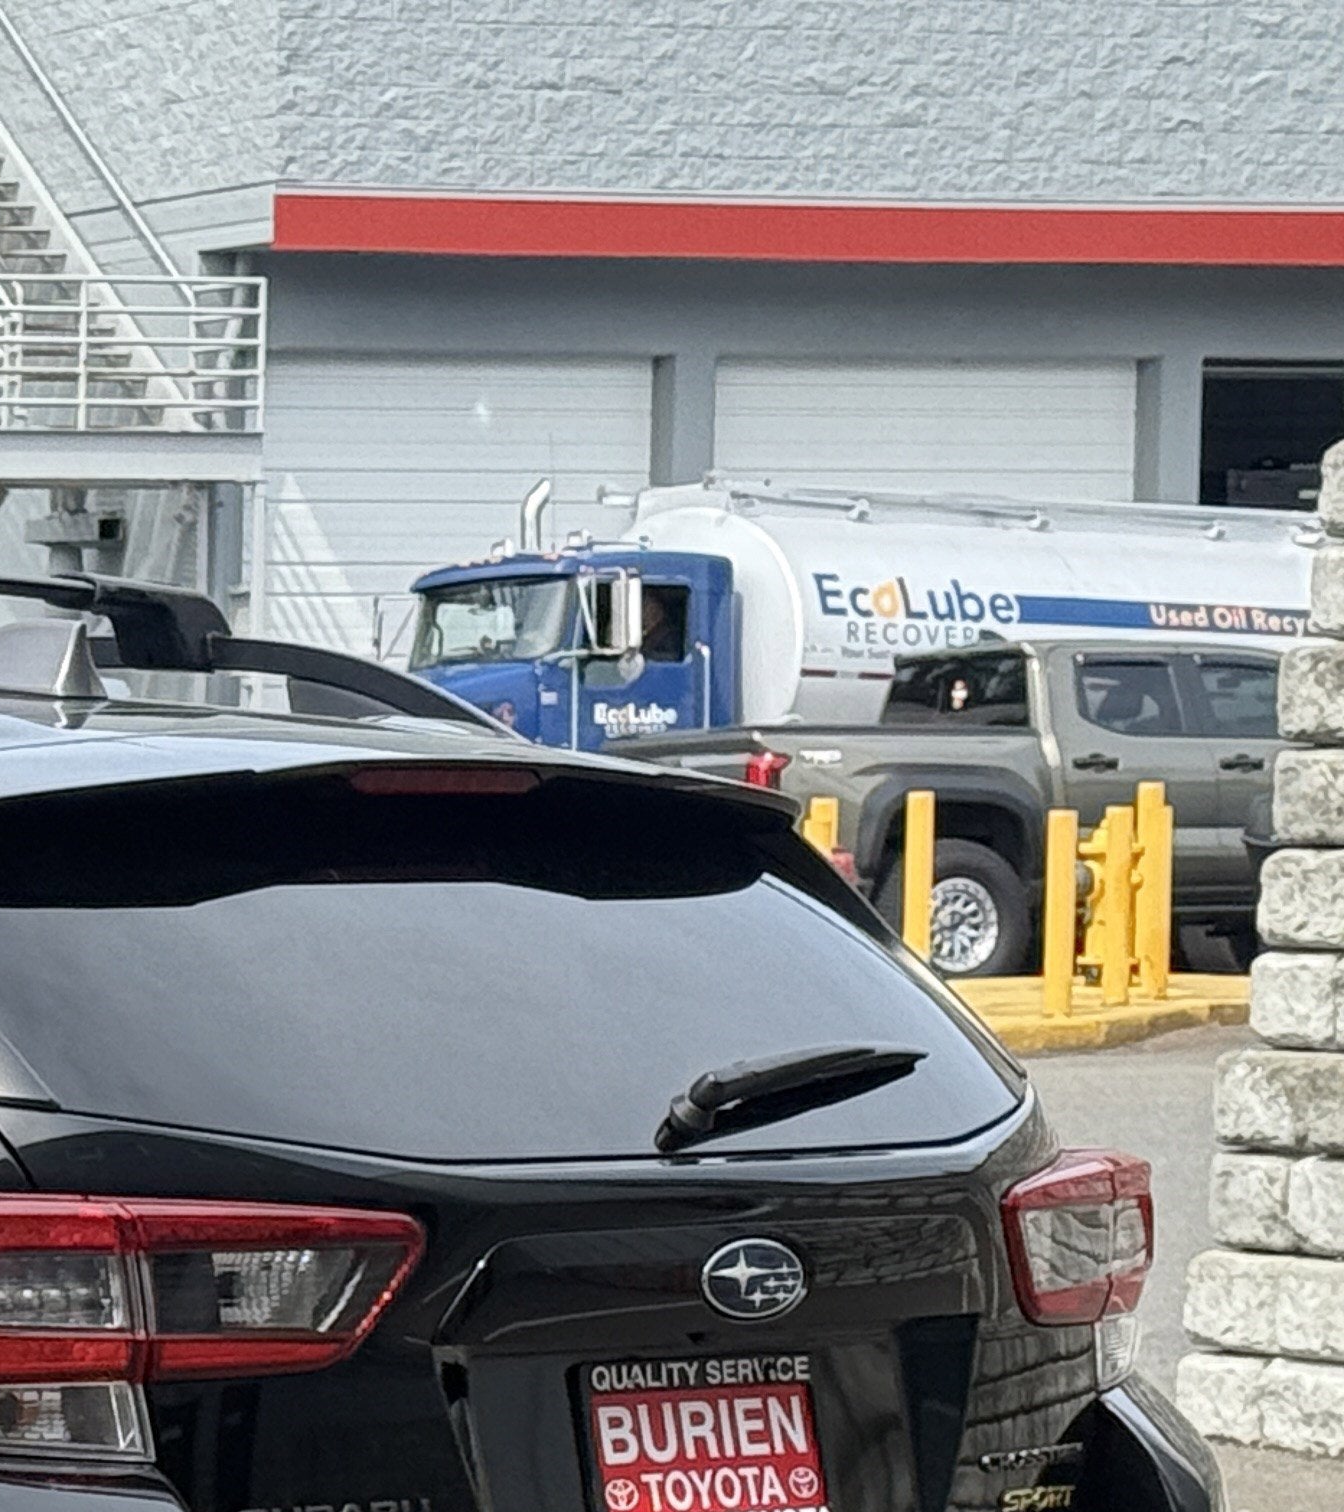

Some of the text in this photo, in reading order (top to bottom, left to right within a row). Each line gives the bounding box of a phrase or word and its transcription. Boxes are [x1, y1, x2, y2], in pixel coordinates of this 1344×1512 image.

[812, 573, 1015, 624] EcoLube
[1150, 604, 1207, 627] Used
[1213, 605, 1247, 630] Oil
[846, 621, 975, 647] RECOVER
[593, 702, 678, 725] EcoLube
[591, 1360, 700, 1392] QUALITY
[596, 1394, 810, 1466] BURIEN
